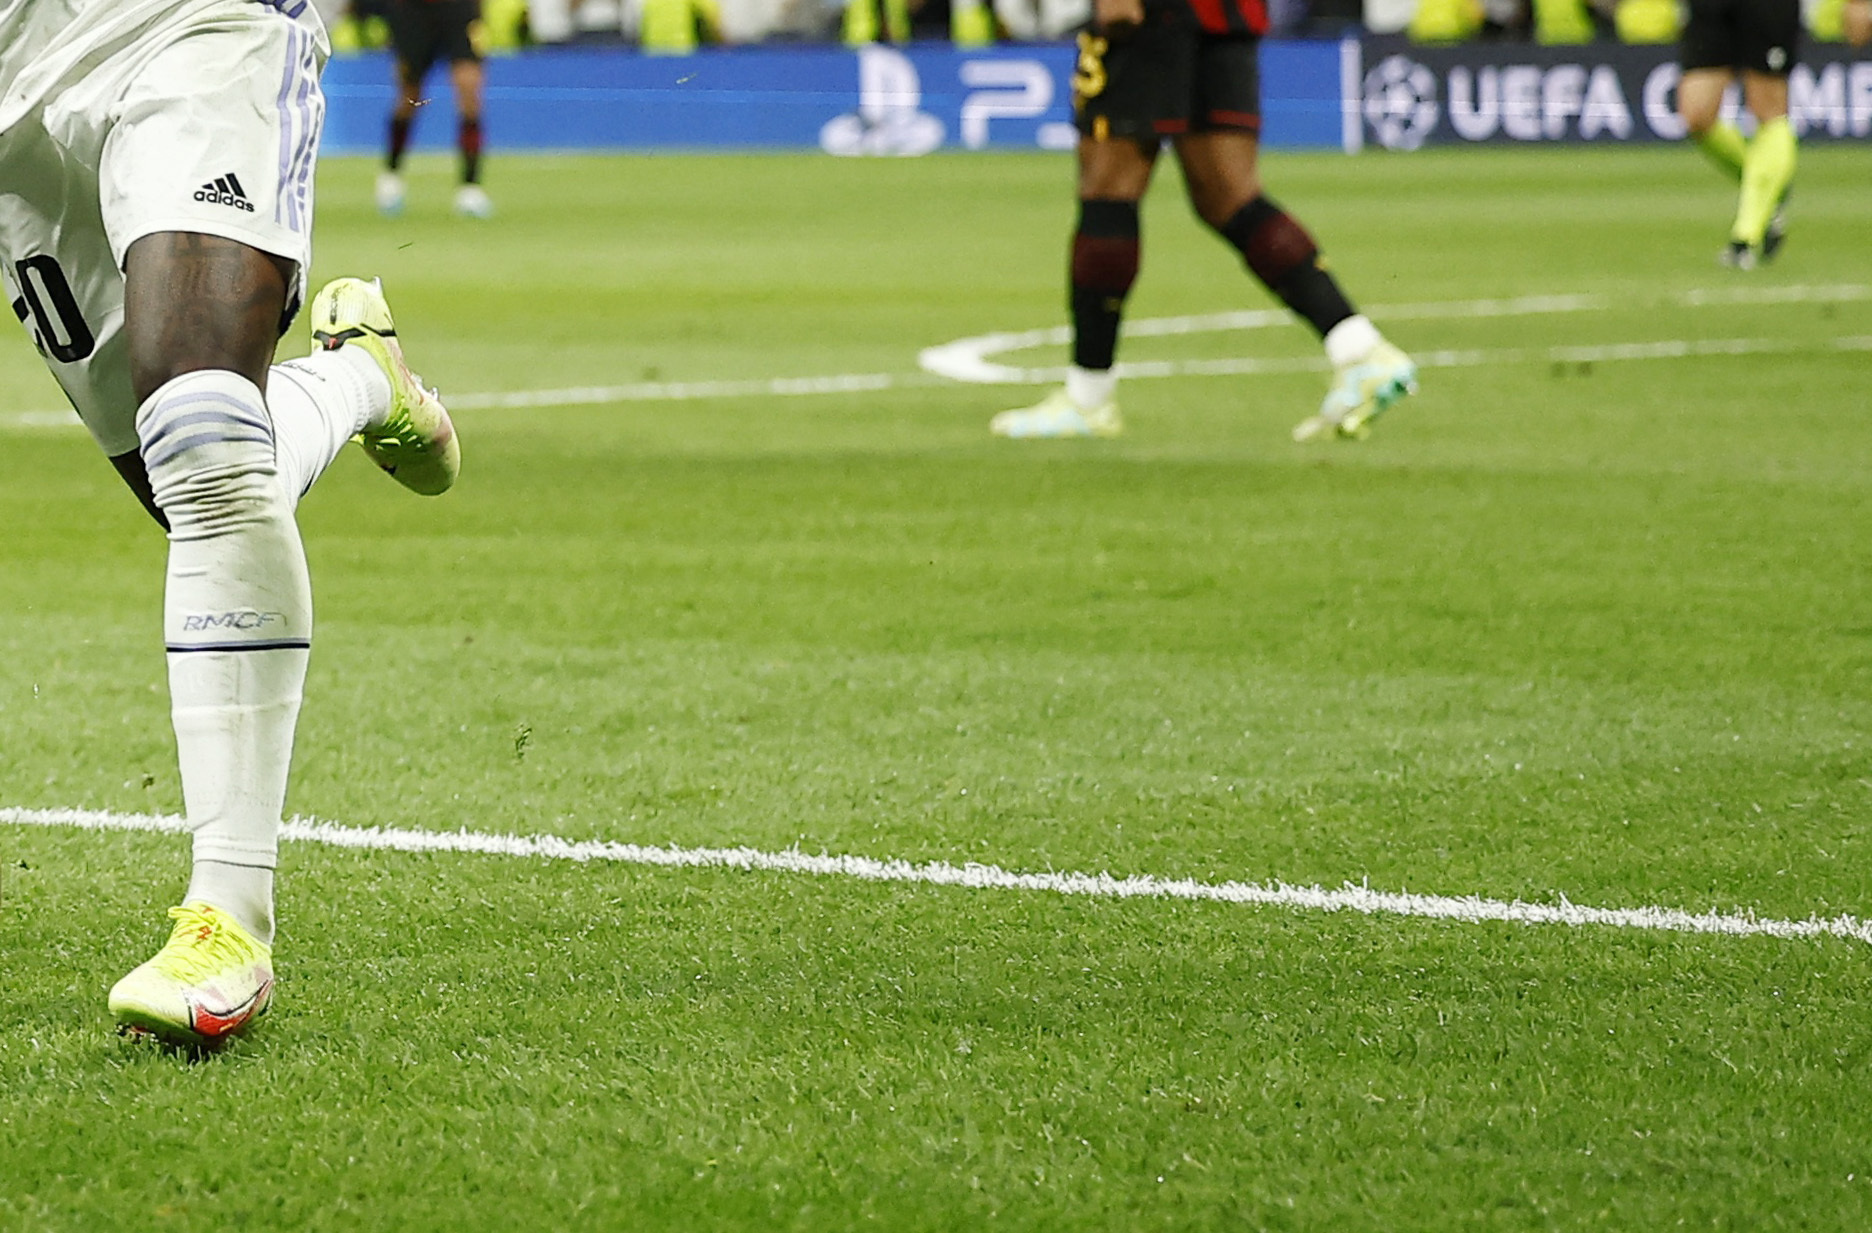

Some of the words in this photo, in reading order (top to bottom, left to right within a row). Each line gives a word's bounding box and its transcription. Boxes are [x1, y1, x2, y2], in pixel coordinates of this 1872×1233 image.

[1447, 63, 1632, 142] UEFA
[193, 189, 255, 213] adidas
[12, 253, 96, 364] 0
